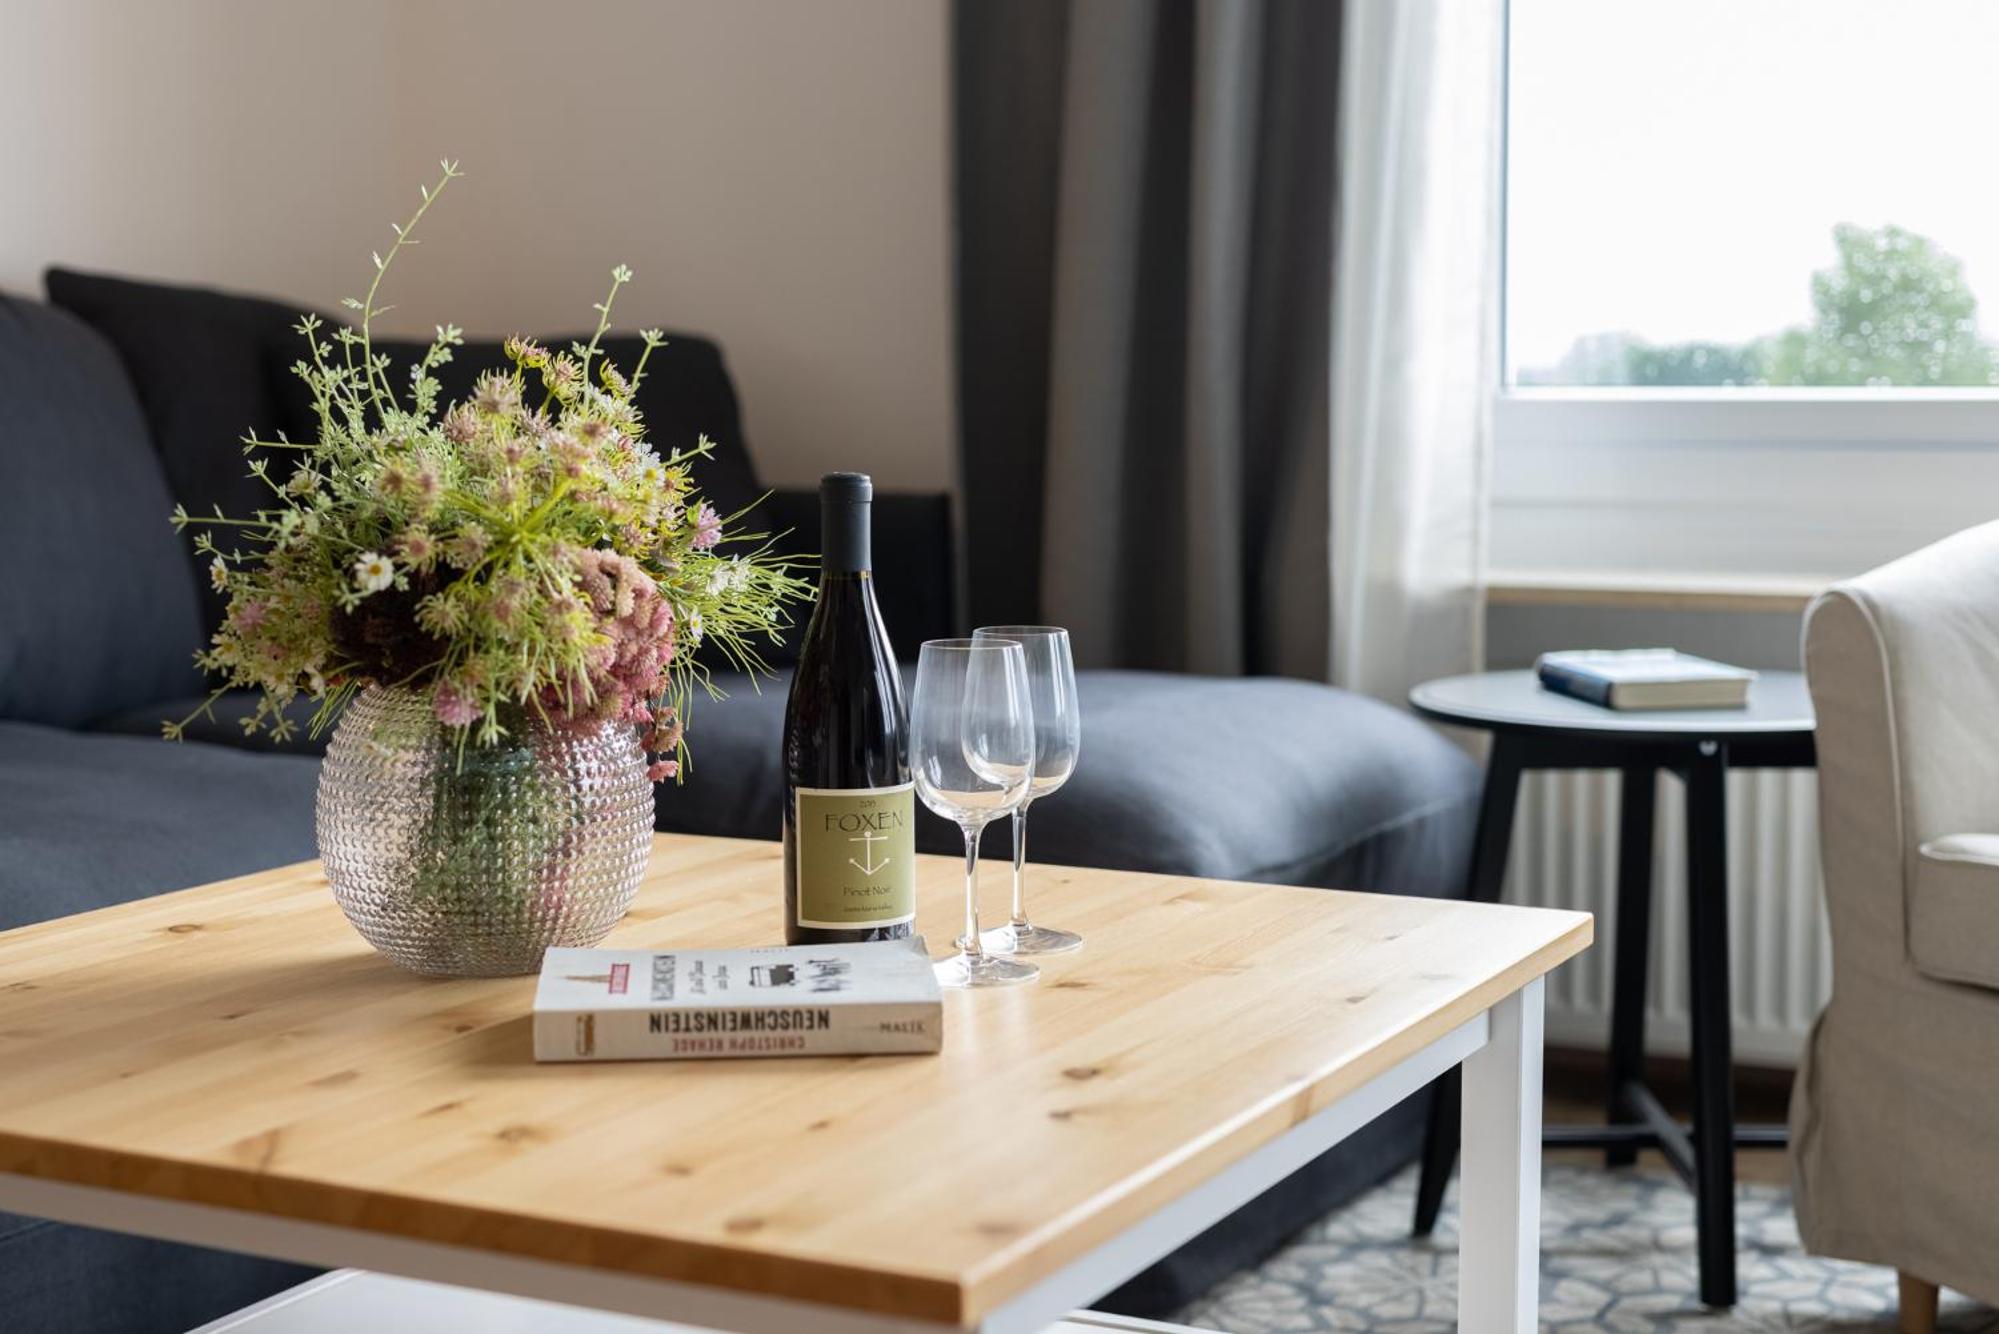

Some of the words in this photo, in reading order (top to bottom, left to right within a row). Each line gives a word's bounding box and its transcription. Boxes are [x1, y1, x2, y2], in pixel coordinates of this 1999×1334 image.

[825, 812, 903, 832] FOXEN
[843, 886, 870, 897] Pinot
[649, 1010, 830, 1033] NEUSCHWEINSTEIN
[729, 1035, 806, 1051] CHRISTOPH
